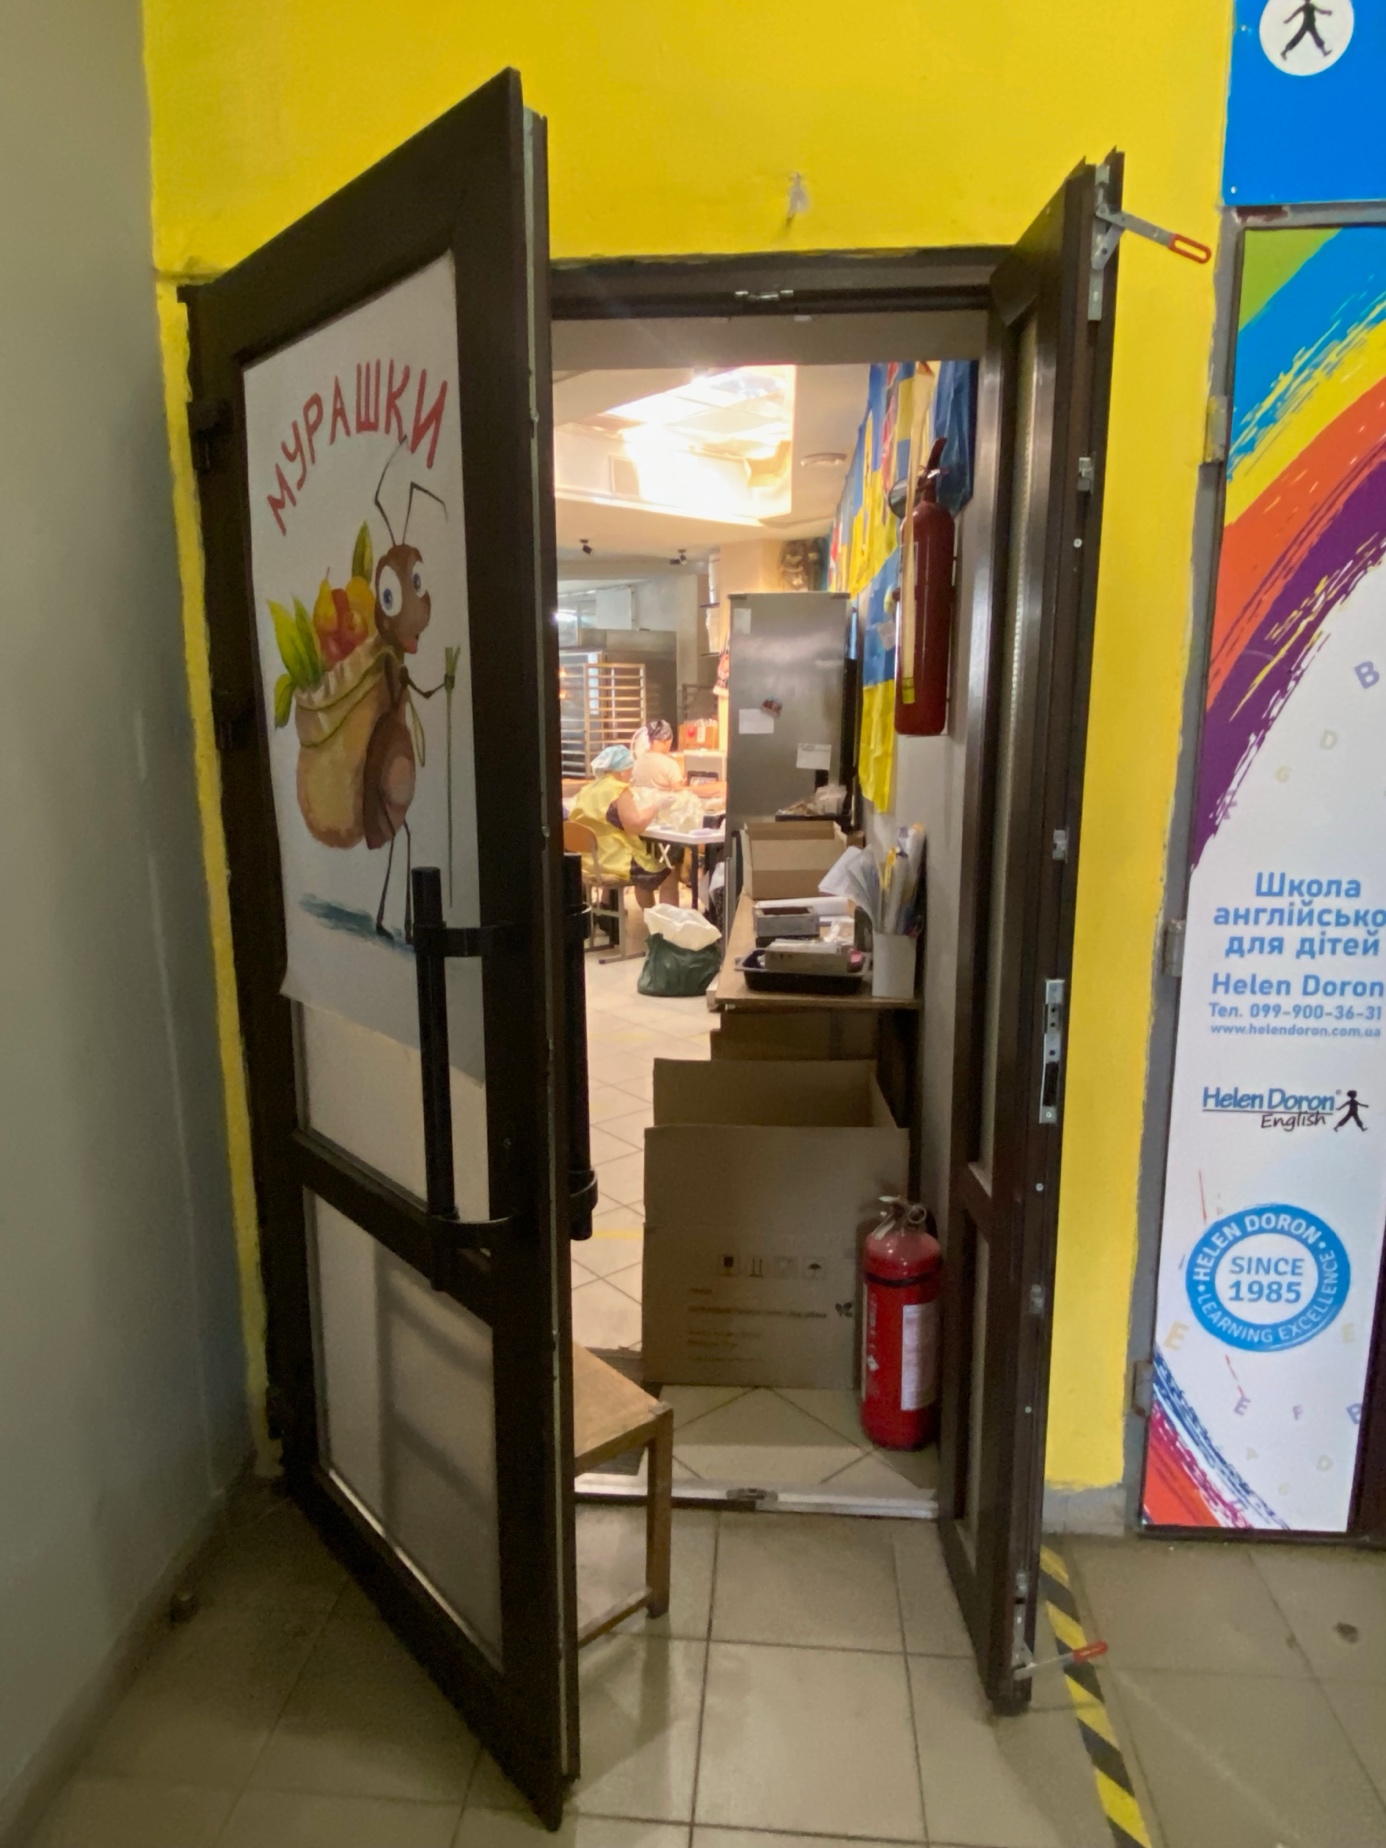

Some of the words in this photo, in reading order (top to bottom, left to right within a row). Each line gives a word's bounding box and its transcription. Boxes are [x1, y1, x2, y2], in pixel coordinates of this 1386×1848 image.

[267, 358, 448, 536] МУРАШКИ
[1354, 661, 1380, 689] B
[1255, 871, 1361, 898] Школа
[1225, 936, 1284, 958] для
[1295, 930, 1380, 959] дітей
[1211, 972, 1292, 996] Helen
[1302, 974, 1385, 998] Doron
[1208, 1002, 1243, 1018] Тел.
[1249, 1003, 1382, 1021] 099-900-36-31
[1210, 1023, 1381, 1038] www.helendoron.com.ua
[1202, 1086, 1264, 1110] Helen
[1267, 1088, 1335, 1112] Doron
[1260, 1111, 1326, 1132] English
[1193, 1222, 1242, 1281] HELEN
[1244, 1212, 1322, 1245] DORON
[1229, 1256, 1305, 1277] SINCE
[1197, 1293, 1273, 1343] LEARNING
[1278, 1250, 1339, 1341] EXCELLENCE
[1228, 1280, 1302, 1303] 1985
